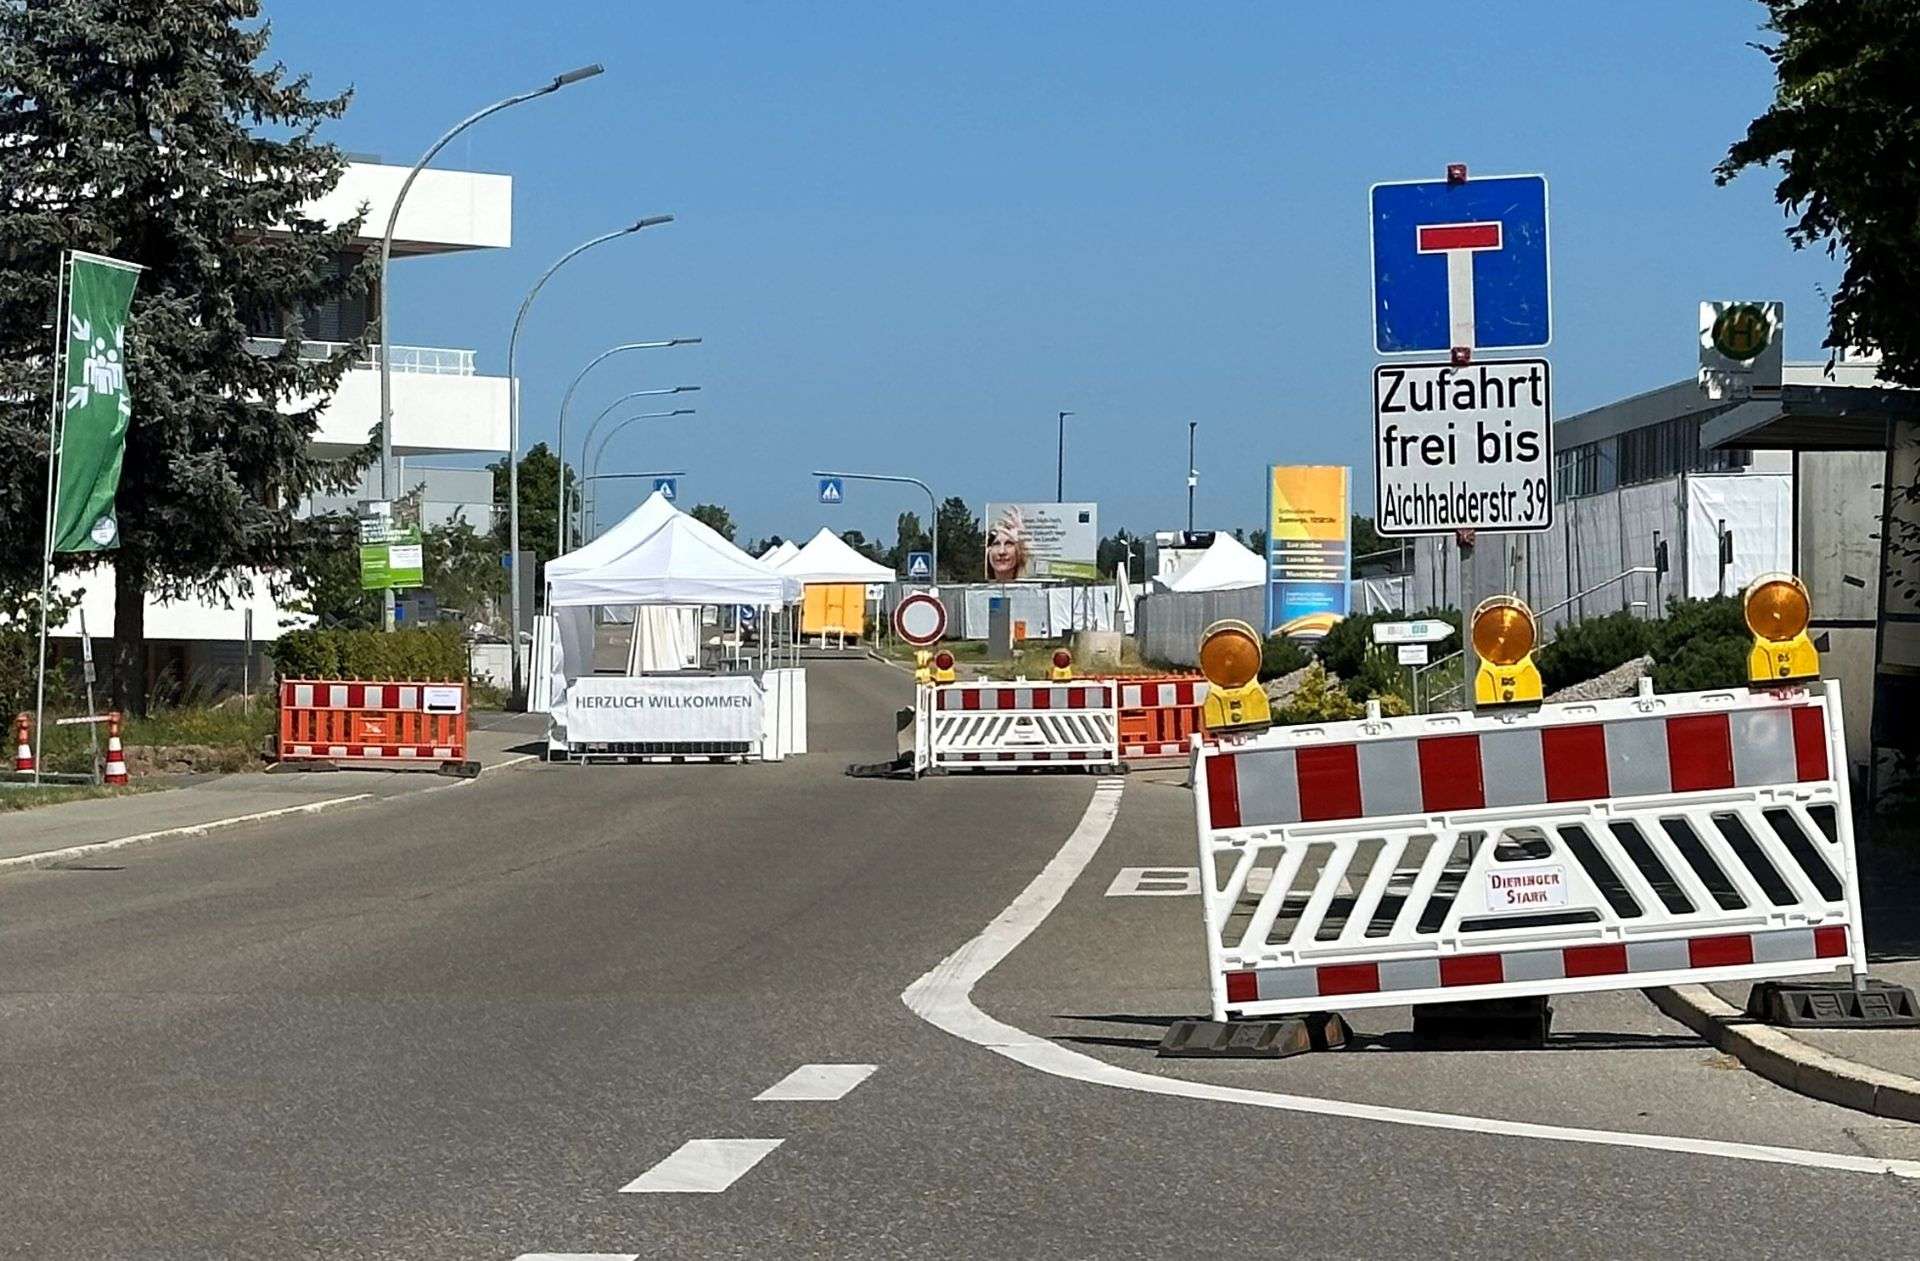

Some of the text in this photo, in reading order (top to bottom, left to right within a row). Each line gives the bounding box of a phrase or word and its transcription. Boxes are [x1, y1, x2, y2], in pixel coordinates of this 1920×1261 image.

[1380, 367, 1543, 413] Zufahrt
[1383, 419, 1540, 467] frei bis
[575, 695, 752, 709] HERZLICH WILLKOMMEN
